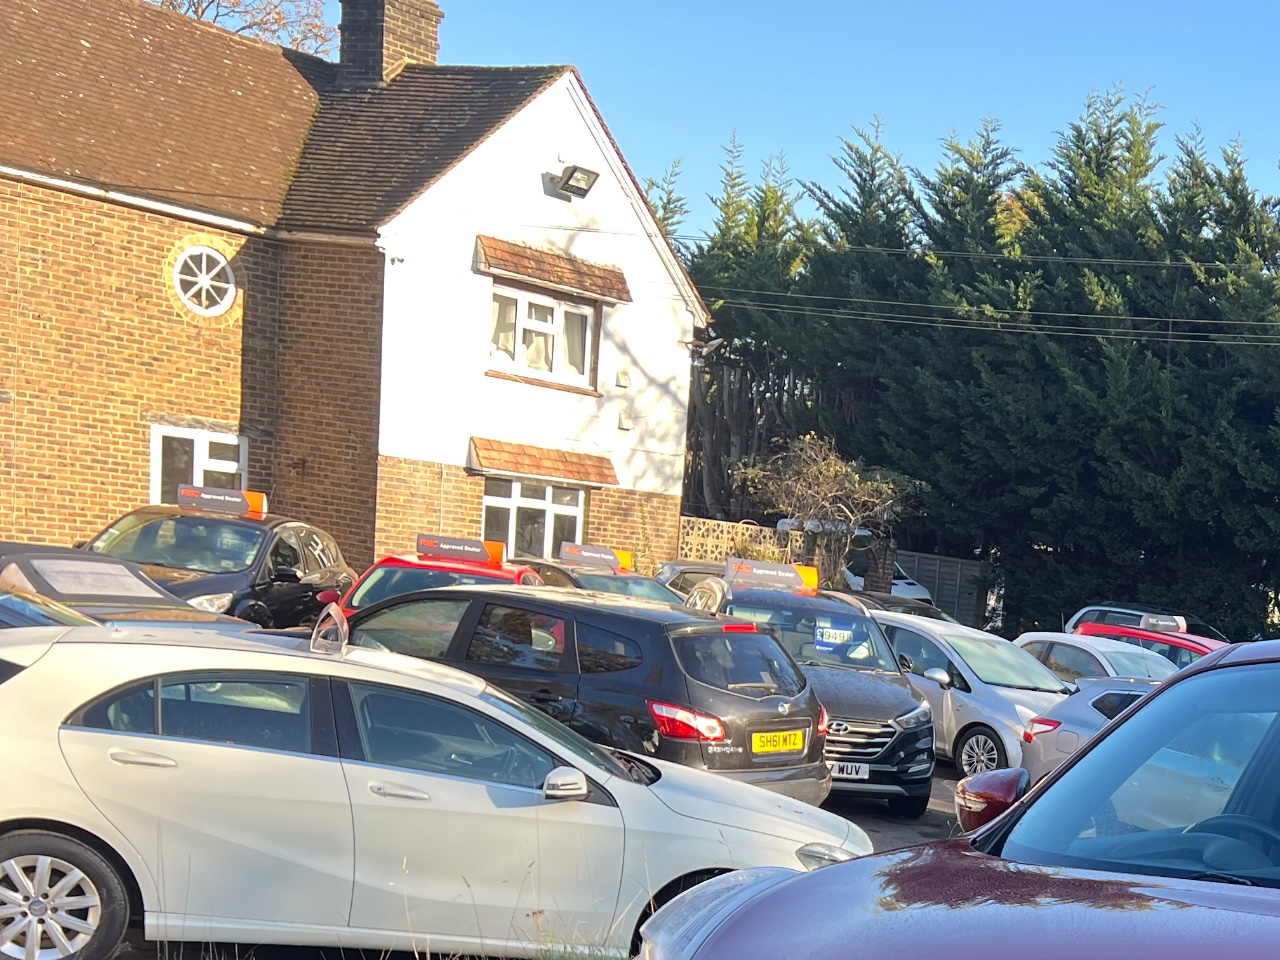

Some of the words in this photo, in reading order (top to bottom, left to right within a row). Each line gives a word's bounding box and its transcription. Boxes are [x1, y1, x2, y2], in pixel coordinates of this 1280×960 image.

[439, 543, 464, 551] Approved
[464, 545, 482, 553] Dealer
[752, 567, 778, 576] Approved
[778, 570, 795, 578] Dealer
[759, 734, 780, 748] SH61
[782, 733, 798, 747] MTZ
[838, 763, 861, 776] WUV
